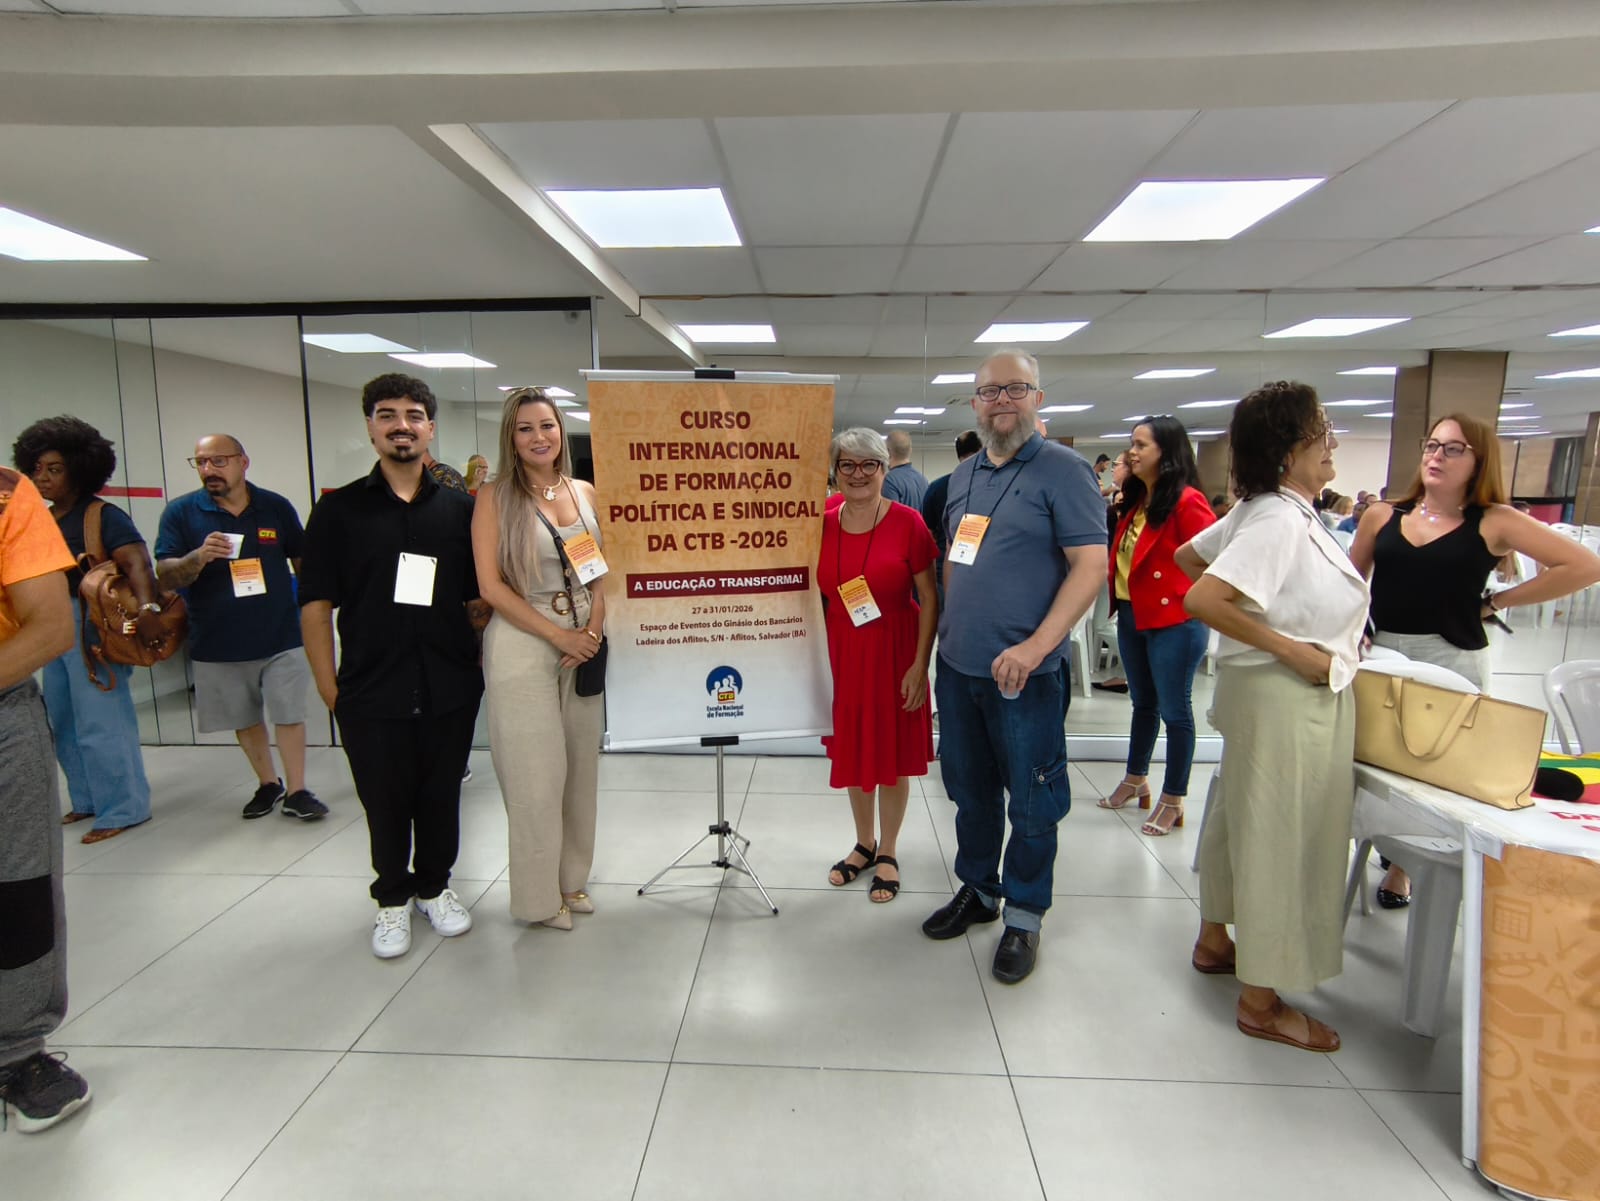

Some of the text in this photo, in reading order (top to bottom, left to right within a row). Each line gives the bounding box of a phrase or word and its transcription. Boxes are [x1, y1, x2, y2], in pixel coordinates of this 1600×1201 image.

[680, 410, 751, 429] CURSO
[629, 441, 800, 461] INTERNACIONAL
[639, 469, 792, 494] DE FORMAÇÃO
[609, 500, 820, 522] POLÍTICA E SINDICAL
[648, 534, 677, 552] DA
[683, 532, 724, 551] CTB
[634, 574, 803, 592] A EDUCAÇÃO TRANSFORMA!
[692, 607, 701, 615] 27
[709, 605, 753, 614] 31/01/2026
[640, 616, 803, 632] Espaço de Eventos do Ginásio dos Bancários
[636, 637, 665, 646] Ladeira
[666, 636, 680, 645] dos
[682, 635, 709, 643] Aflitos,
[710, 634, 724, 642] S/N
[730, 633, 757, 641] Aflitos,
[758, 631, 791, 641] Salvador
[792, 629, 807, 639] (BA)
